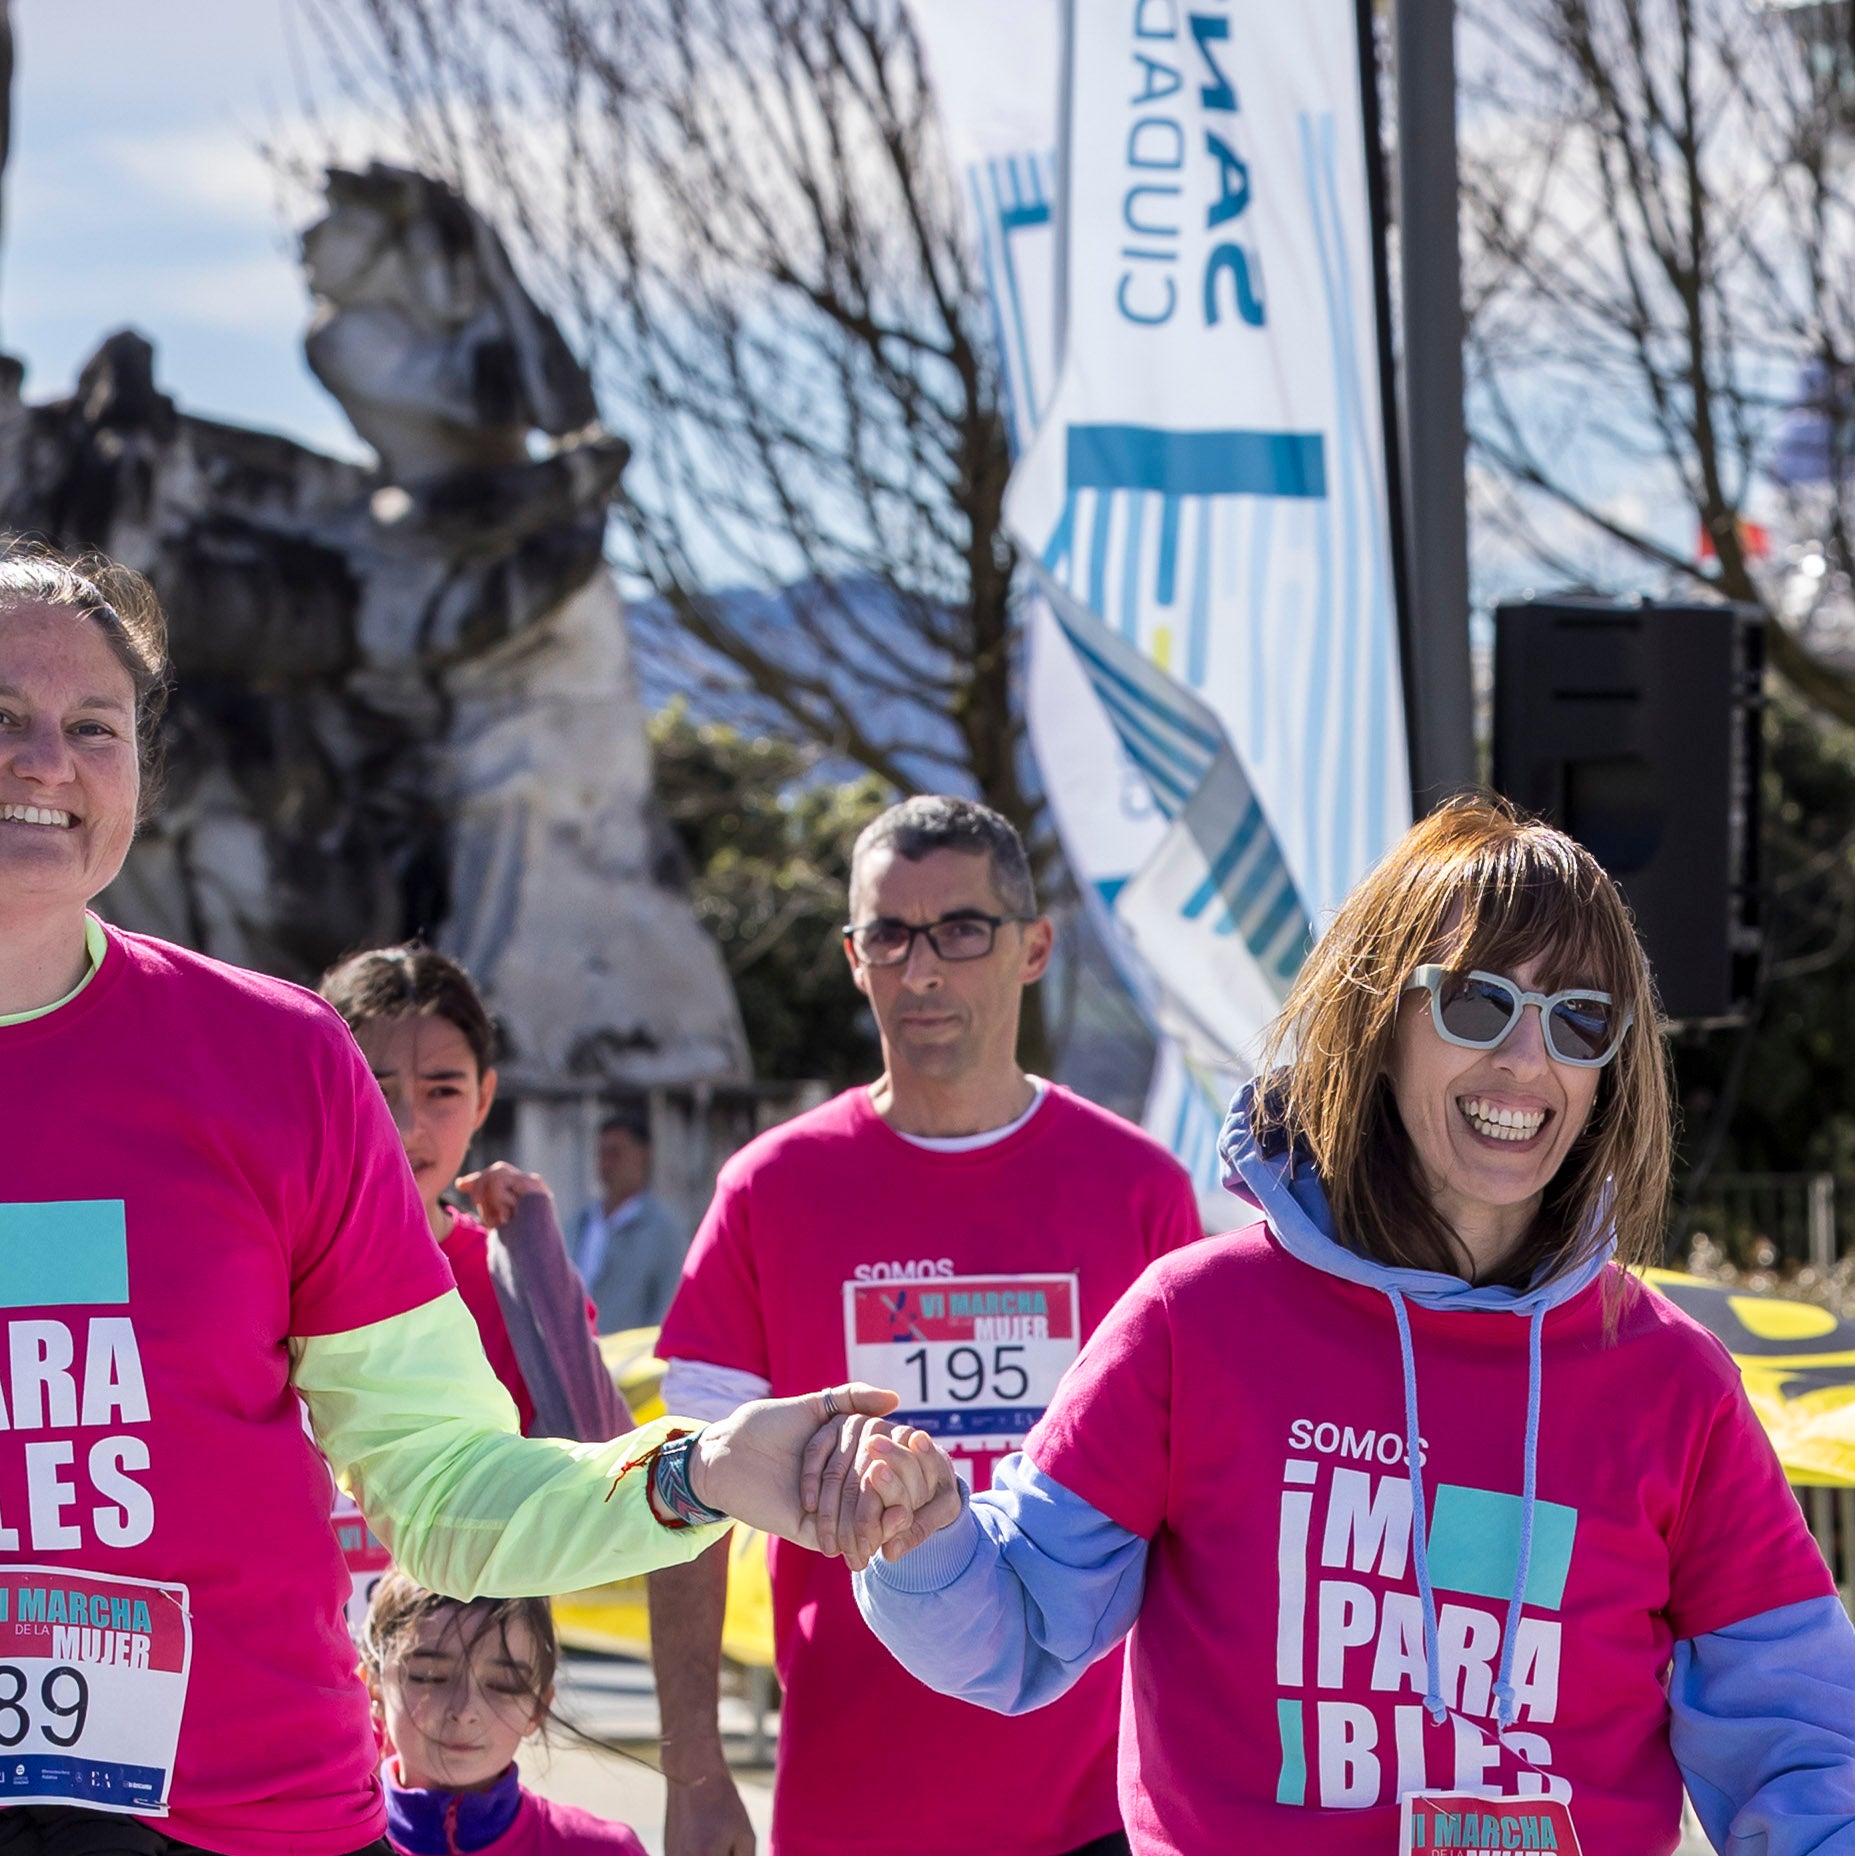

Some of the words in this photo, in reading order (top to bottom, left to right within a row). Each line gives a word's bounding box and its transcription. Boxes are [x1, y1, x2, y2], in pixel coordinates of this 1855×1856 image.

[854, 1258, 955, 1281] SOMOS
[919, 1292, 943, 1318] VI
[950, 1291, 1048, 1316] MARCHA
[974, 1316, 1049, 1341] MUJER
[905, 1345, 1029, 1403] 195
[1288, 1418, 1430, 1468] SOMOS
[17, 1587, 153, 1634] MARCHA
[15, 1624, 31, 1636] DE
[34, 1624, 50, 1636] LA
[52, 1625, 152, 1670] MUJER
[1317, 1580, 1562, 1723] PARA
[1434, 1814, 1558, 1850] MARCHA
